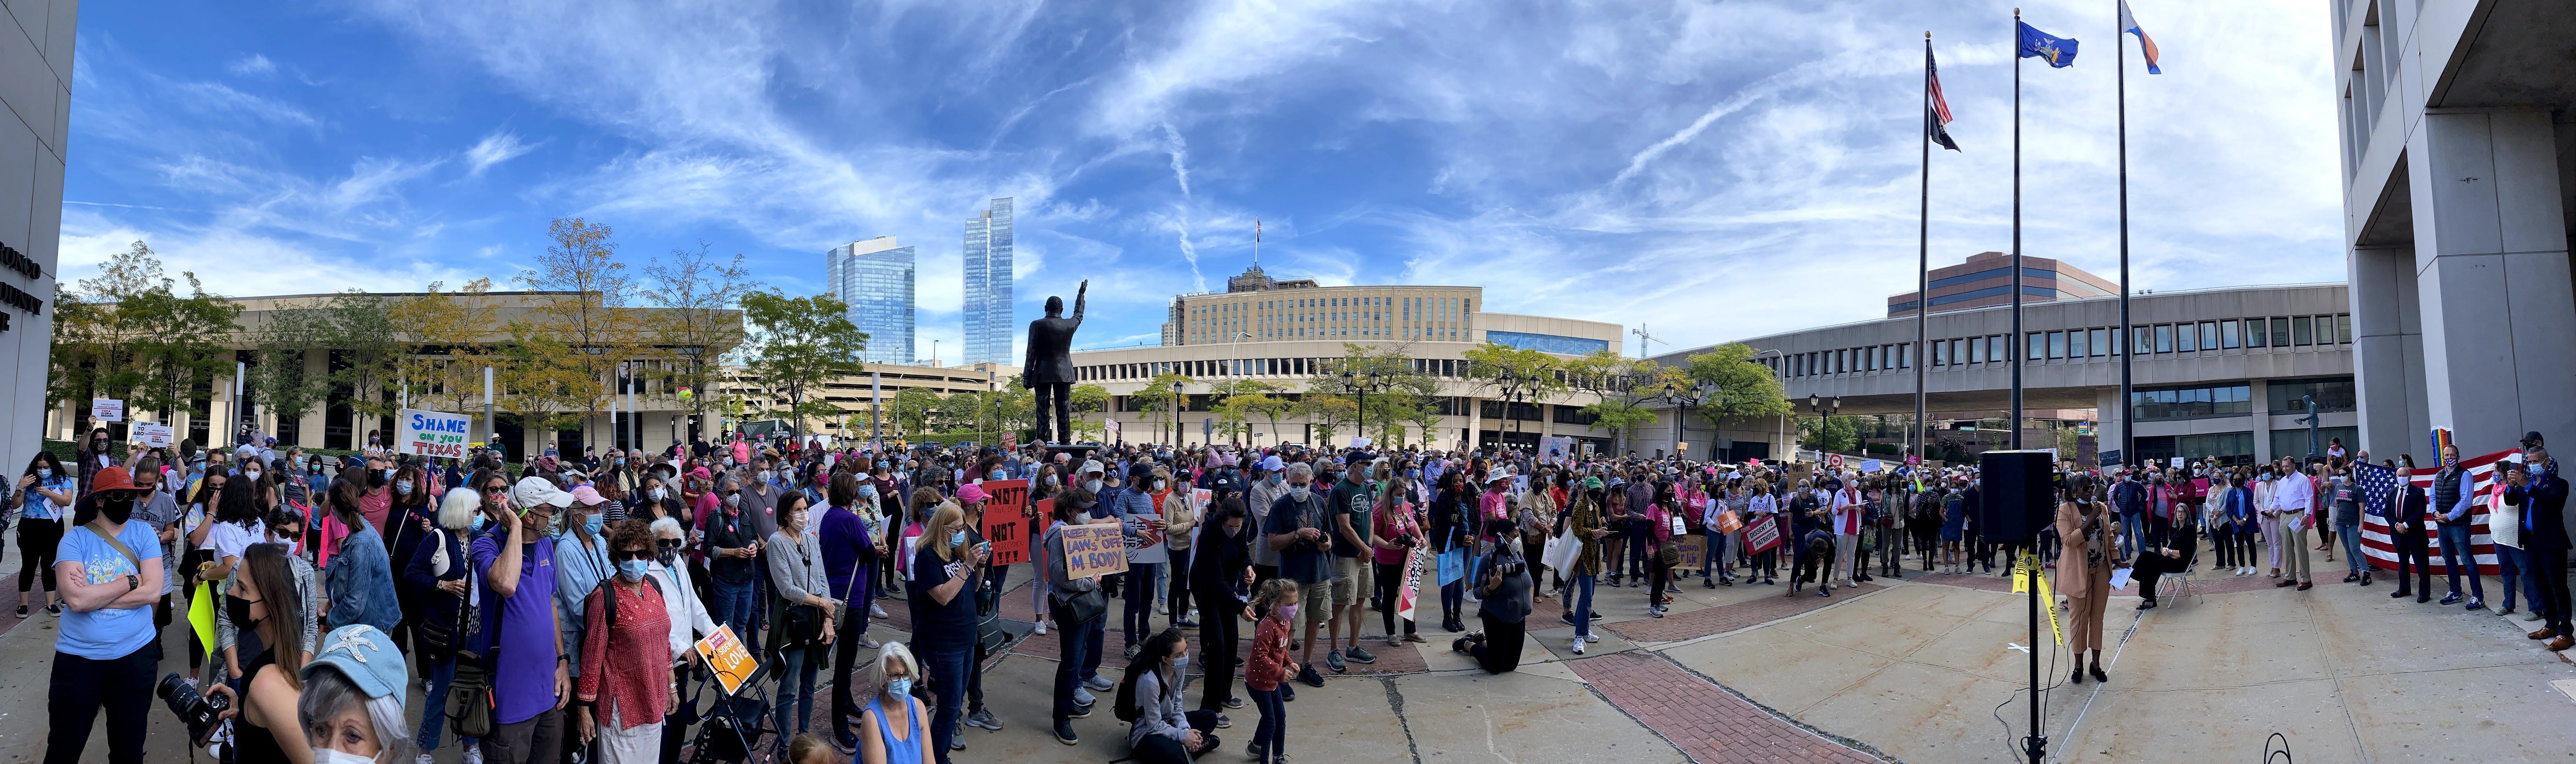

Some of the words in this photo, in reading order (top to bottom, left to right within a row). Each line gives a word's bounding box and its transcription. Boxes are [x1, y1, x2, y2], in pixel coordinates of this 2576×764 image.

[412, 414, 466, 433] SHAME
[419, 433, 435, 441] ON
[413, 441, 462, 457] TEXAS
[990, 522, 1016, 542] NOT
[1063, 528, 1089, 539] KEEP
[1749, 524, 1767, 539] DISSENT
[1756, 530, 1777, 548] PATRIOTIC
[1007, 540, 1024, 550] CHOICE
[1102, 537, 1123, 550] OFF
[1072, 553, 1085, 572] M
[1089, 550, 1122, 570] BODY
[1411, 553, 1426, 597] agenda
[718, 643, 730, 655] SIDE
[727, 635, 740, 648] WITH
[724, 644, 749, 670] LOVE
